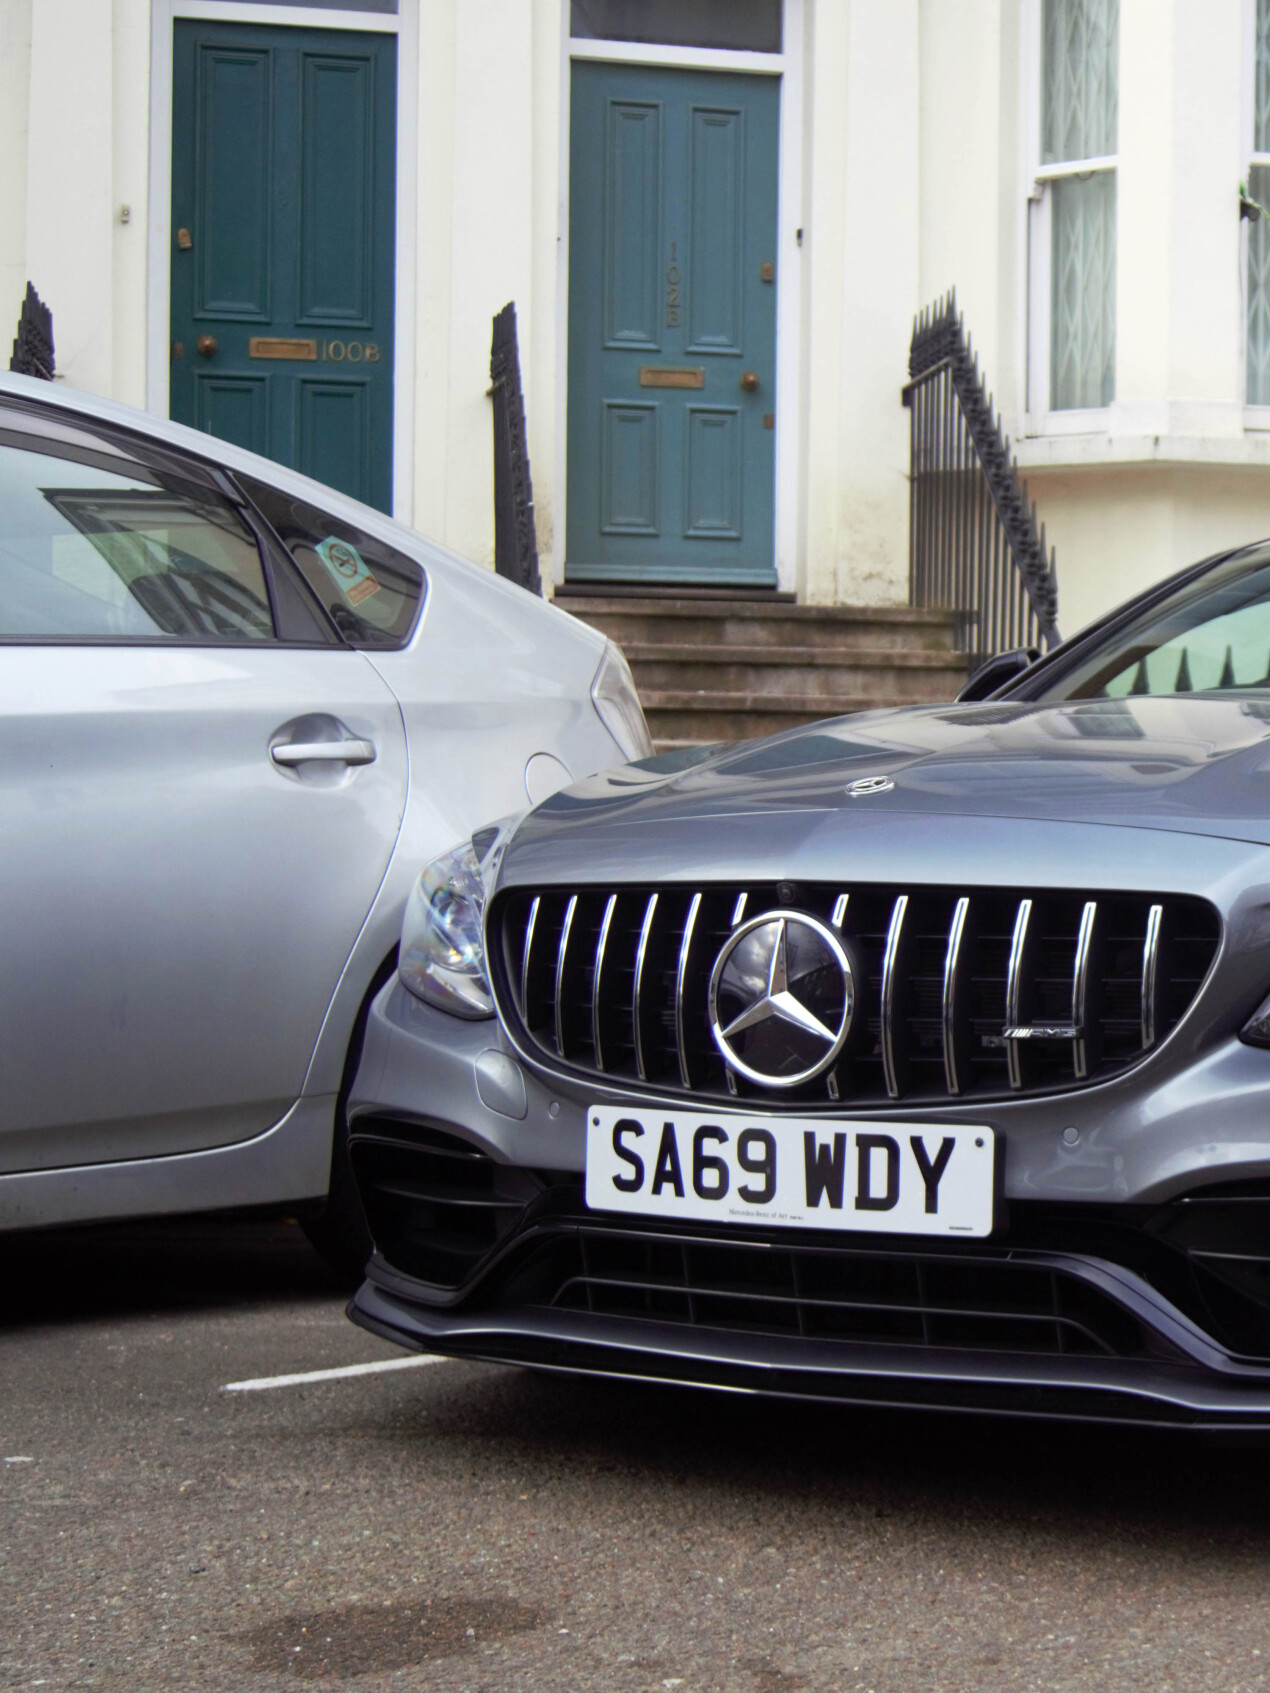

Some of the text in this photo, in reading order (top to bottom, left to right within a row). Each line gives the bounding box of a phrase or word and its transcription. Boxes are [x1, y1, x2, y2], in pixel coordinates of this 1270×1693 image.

[665, 243, 682, 328] 102B
[322, 340, 381, 363] 100B
[611, 1118, 957, 1215] SA69 WDY
